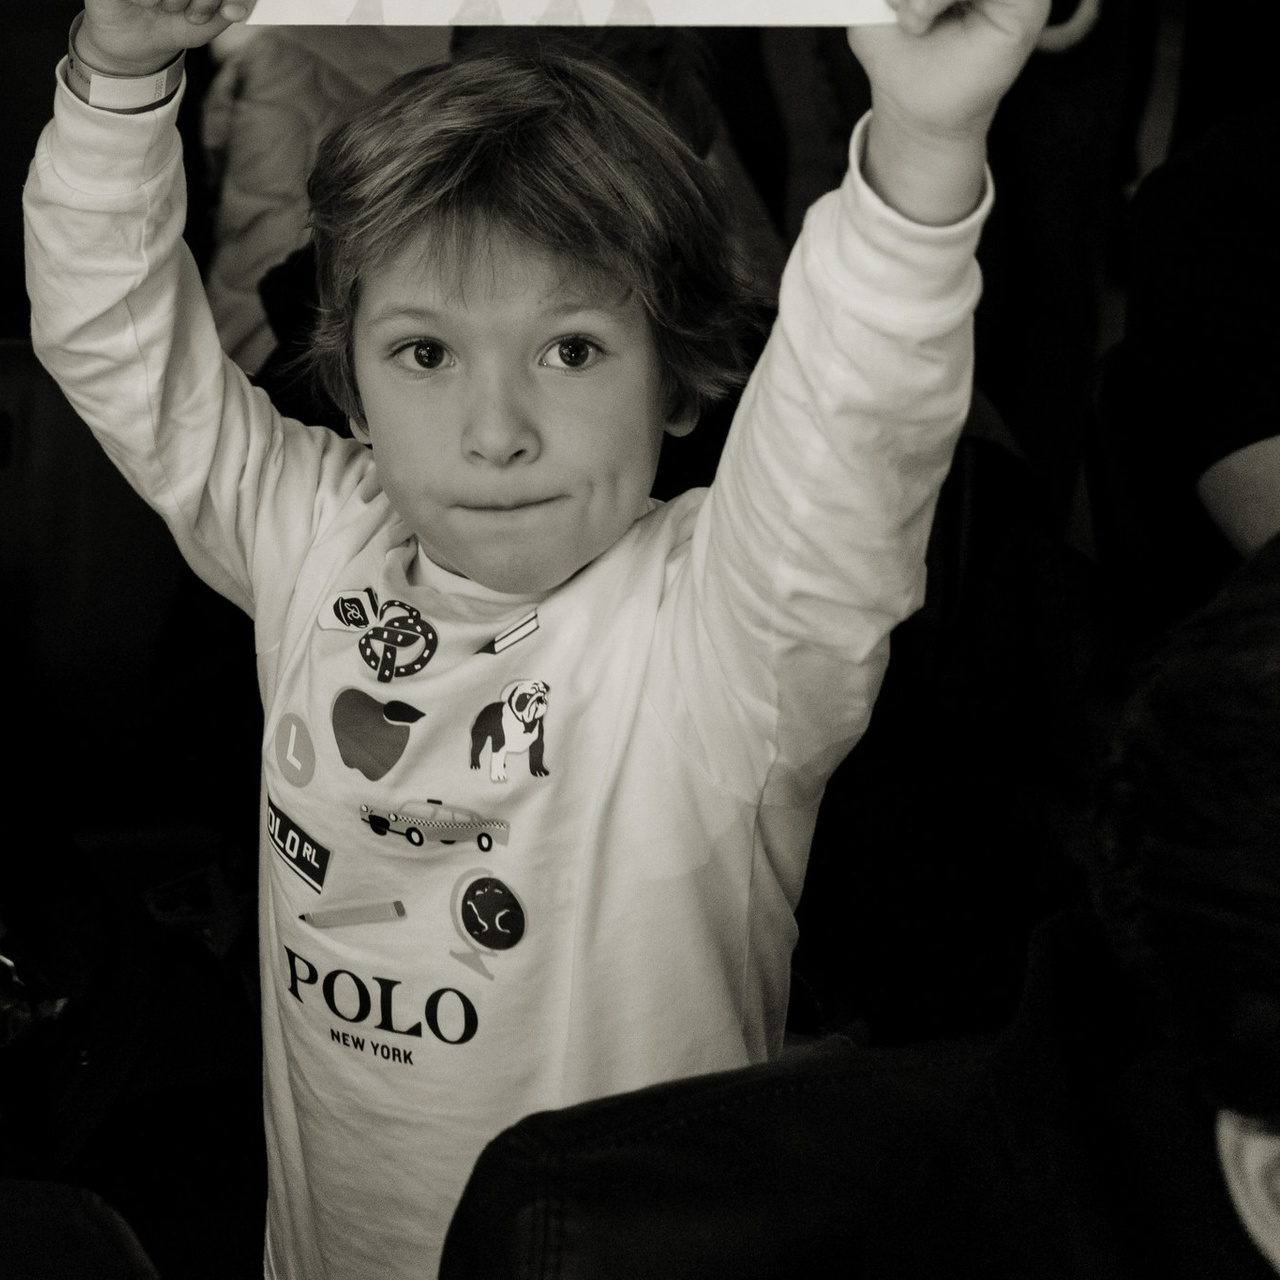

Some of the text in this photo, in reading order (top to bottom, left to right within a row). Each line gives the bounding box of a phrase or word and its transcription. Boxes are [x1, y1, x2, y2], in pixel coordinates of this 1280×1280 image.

[286, 723, 302, 772] L
[269, 806, 320, 869] OLO RL
[284, 944, 478, 1045] POLO
[330, 1028, 414, 1065] NEW YORK
